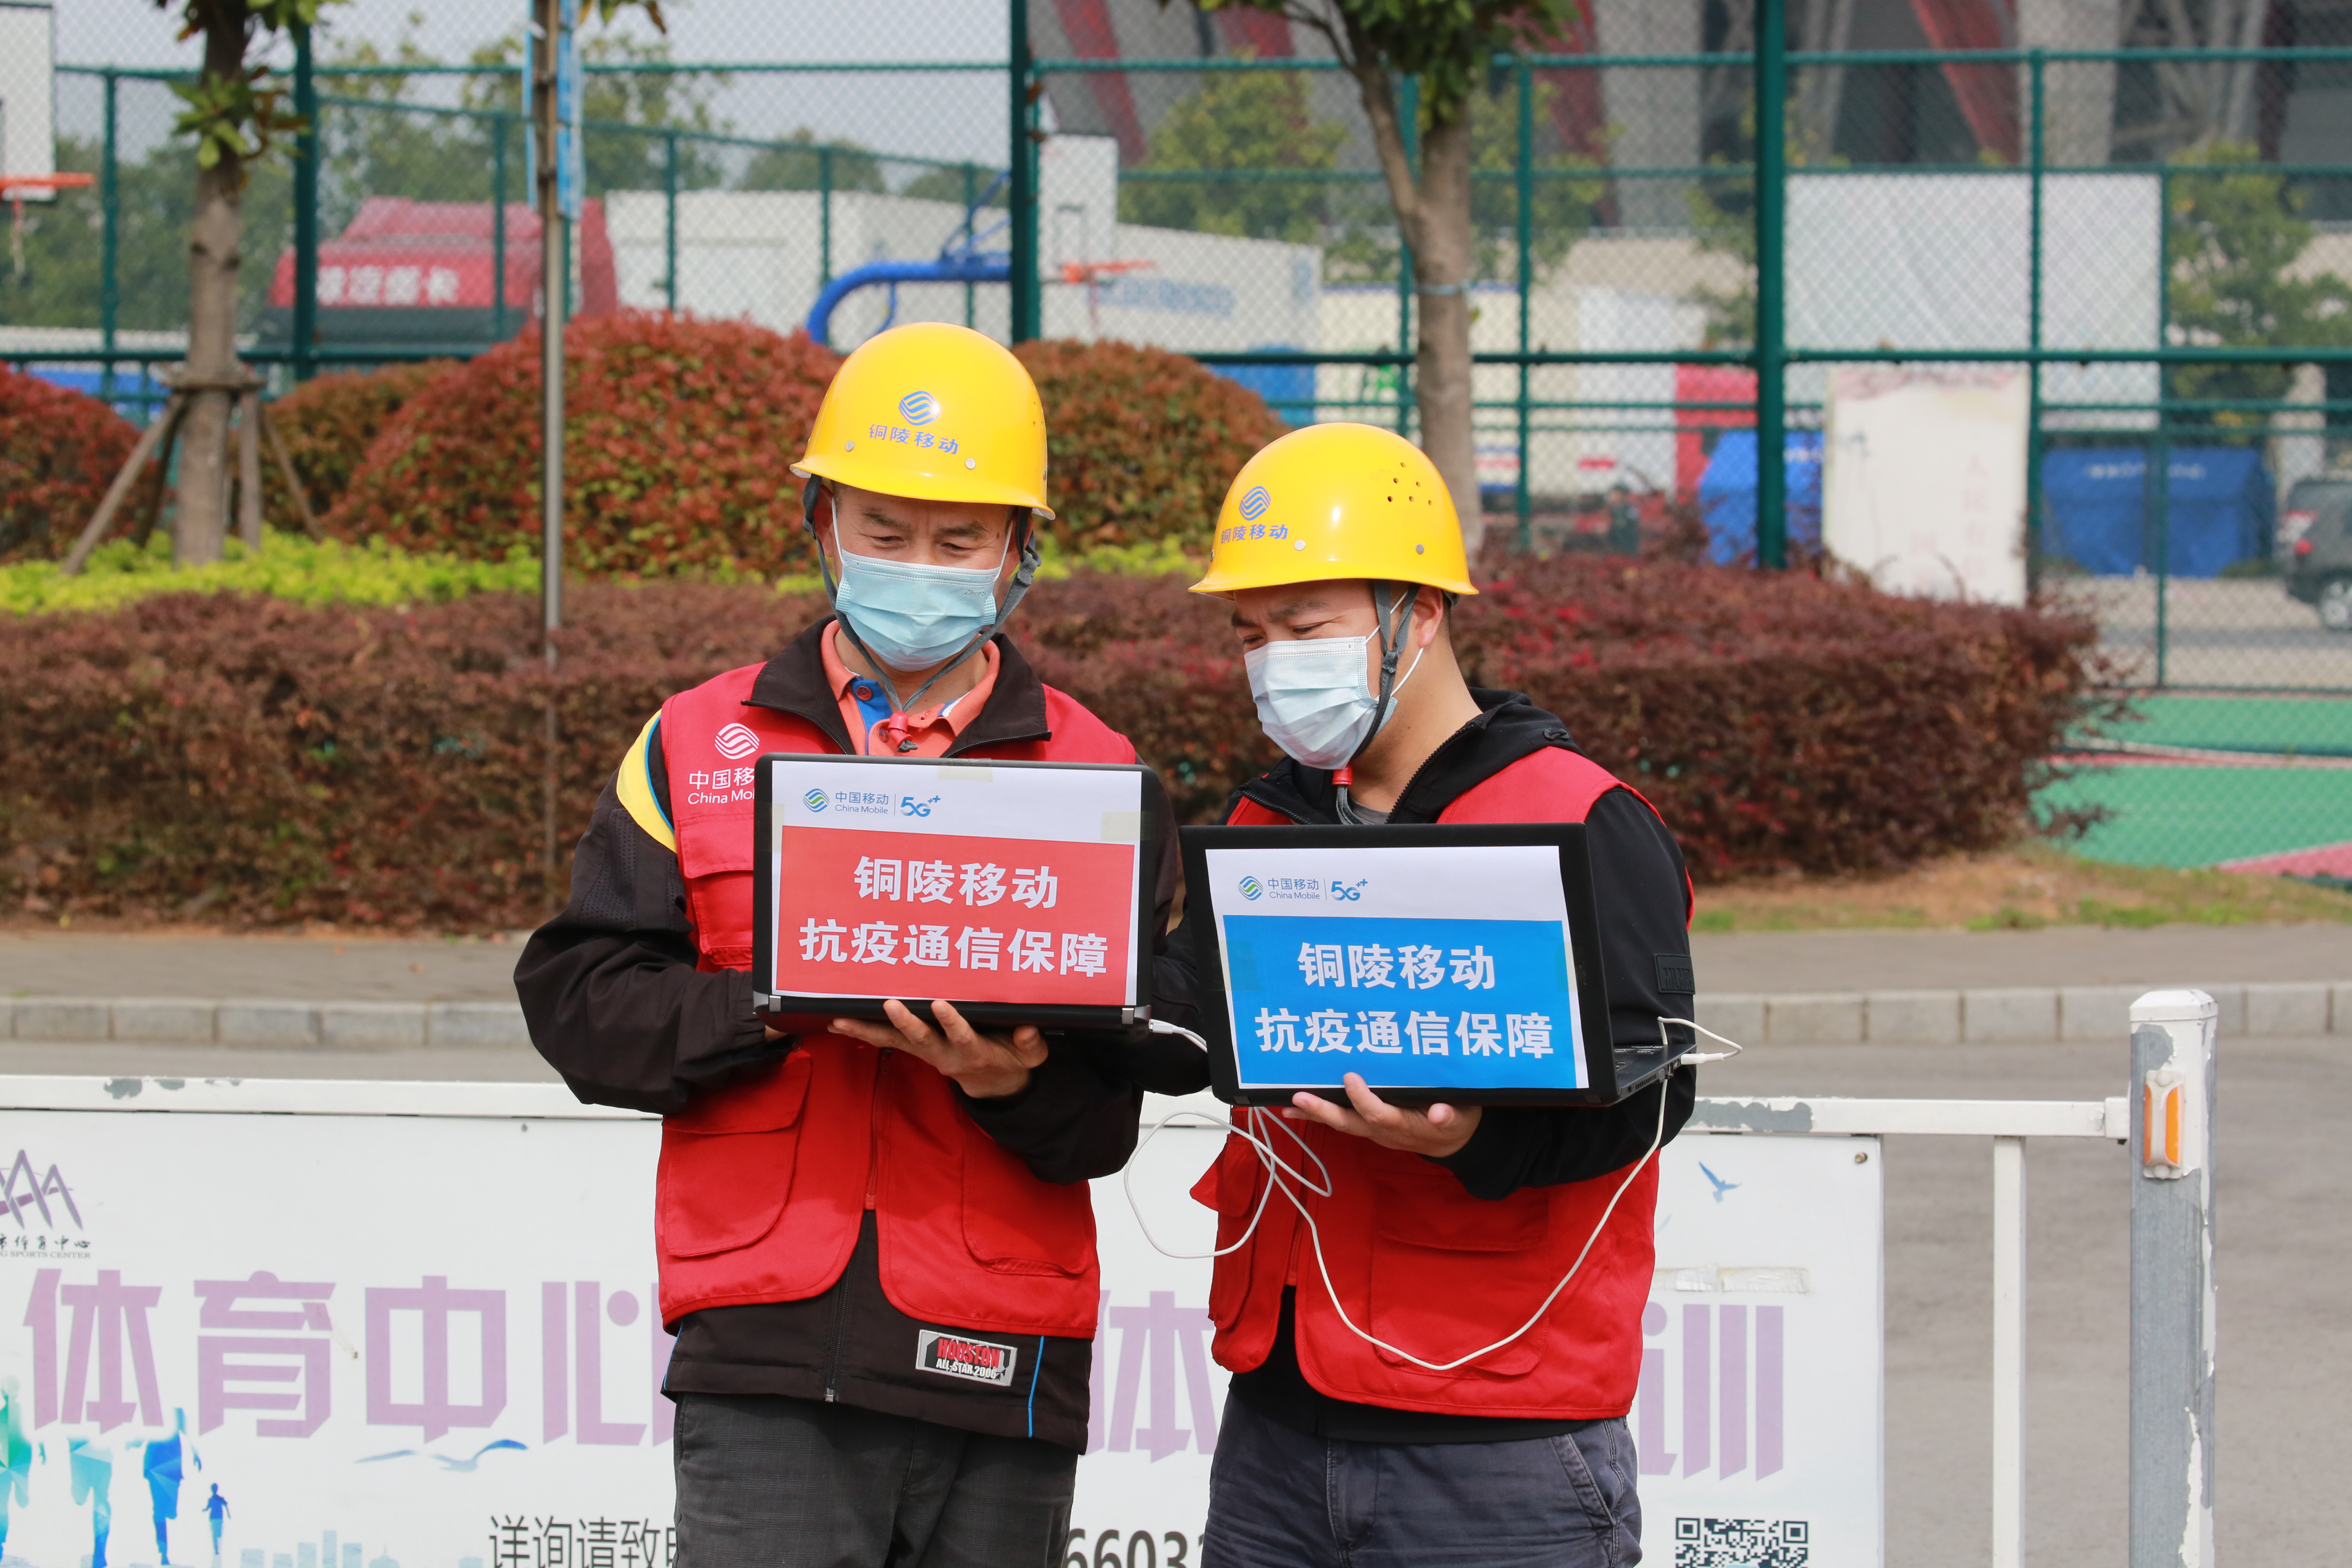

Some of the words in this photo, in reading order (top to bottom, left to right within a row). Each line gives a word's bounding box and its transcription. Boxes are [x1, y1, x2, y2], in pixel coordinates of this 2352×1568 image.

[869, 424, 960, 454] 铜陵移动
[1221, 523, 1288, 545] 铜陵移动
[688, 766, 755, 790] 中国移
[688, 792, 728, 804] China
[731, 788, 755, 802] Mo
[835, 791, 889, 805] 中国移动
[835, 804, 859, 813] China
[861, 806, 889, 814] Mobile
[853, 855, 1058, 909] 铜陵移动
[1267, 878, 1319, 891] 中国移动
[1269, 891, 1292, 899] China
[798, 918, 1108, 978] 抗疫通信保障
[1297, 942, 1495, 990] 铜陵移动
[1254, 1007, 1554, 1059] 抗疫通信保障
[22, 1267, 676, 1447] 体育中心
[937, 1338, 1001, 1368] HOUSTON
[935, 1358, 973, 1374] ALL-STAR
[973, 1366, 998, 1379] 2006
[1062, 1528, 1205, 1568] 6603
